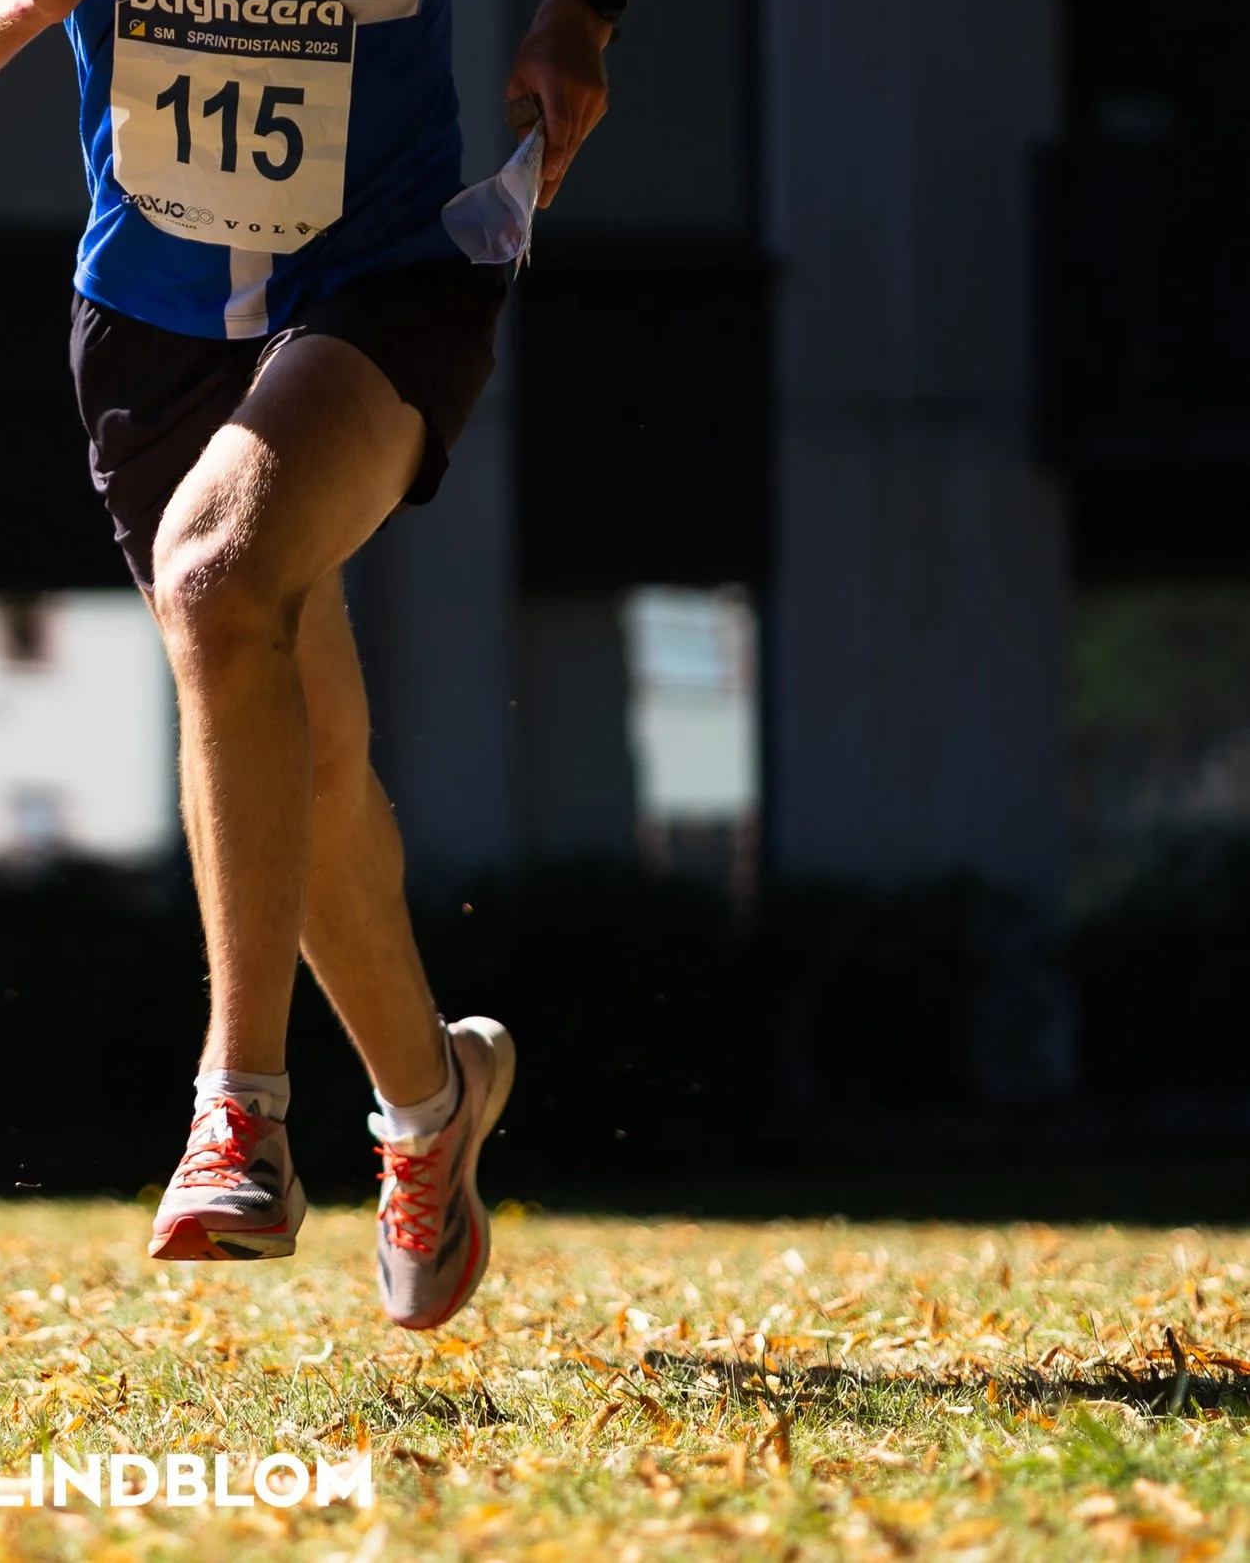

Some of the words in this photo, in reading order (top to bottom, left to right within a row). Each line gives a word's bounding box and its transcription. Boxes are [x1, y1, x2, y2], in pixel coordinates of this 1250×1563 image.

[154, 27, 175, 40] SM
[187, 30, 301, 52] SPRINTDISTANS
[305, 40, 338, 55] 2025
[156, 74, 305, 181] 115
[224, 220, 314, 236] VOLV
